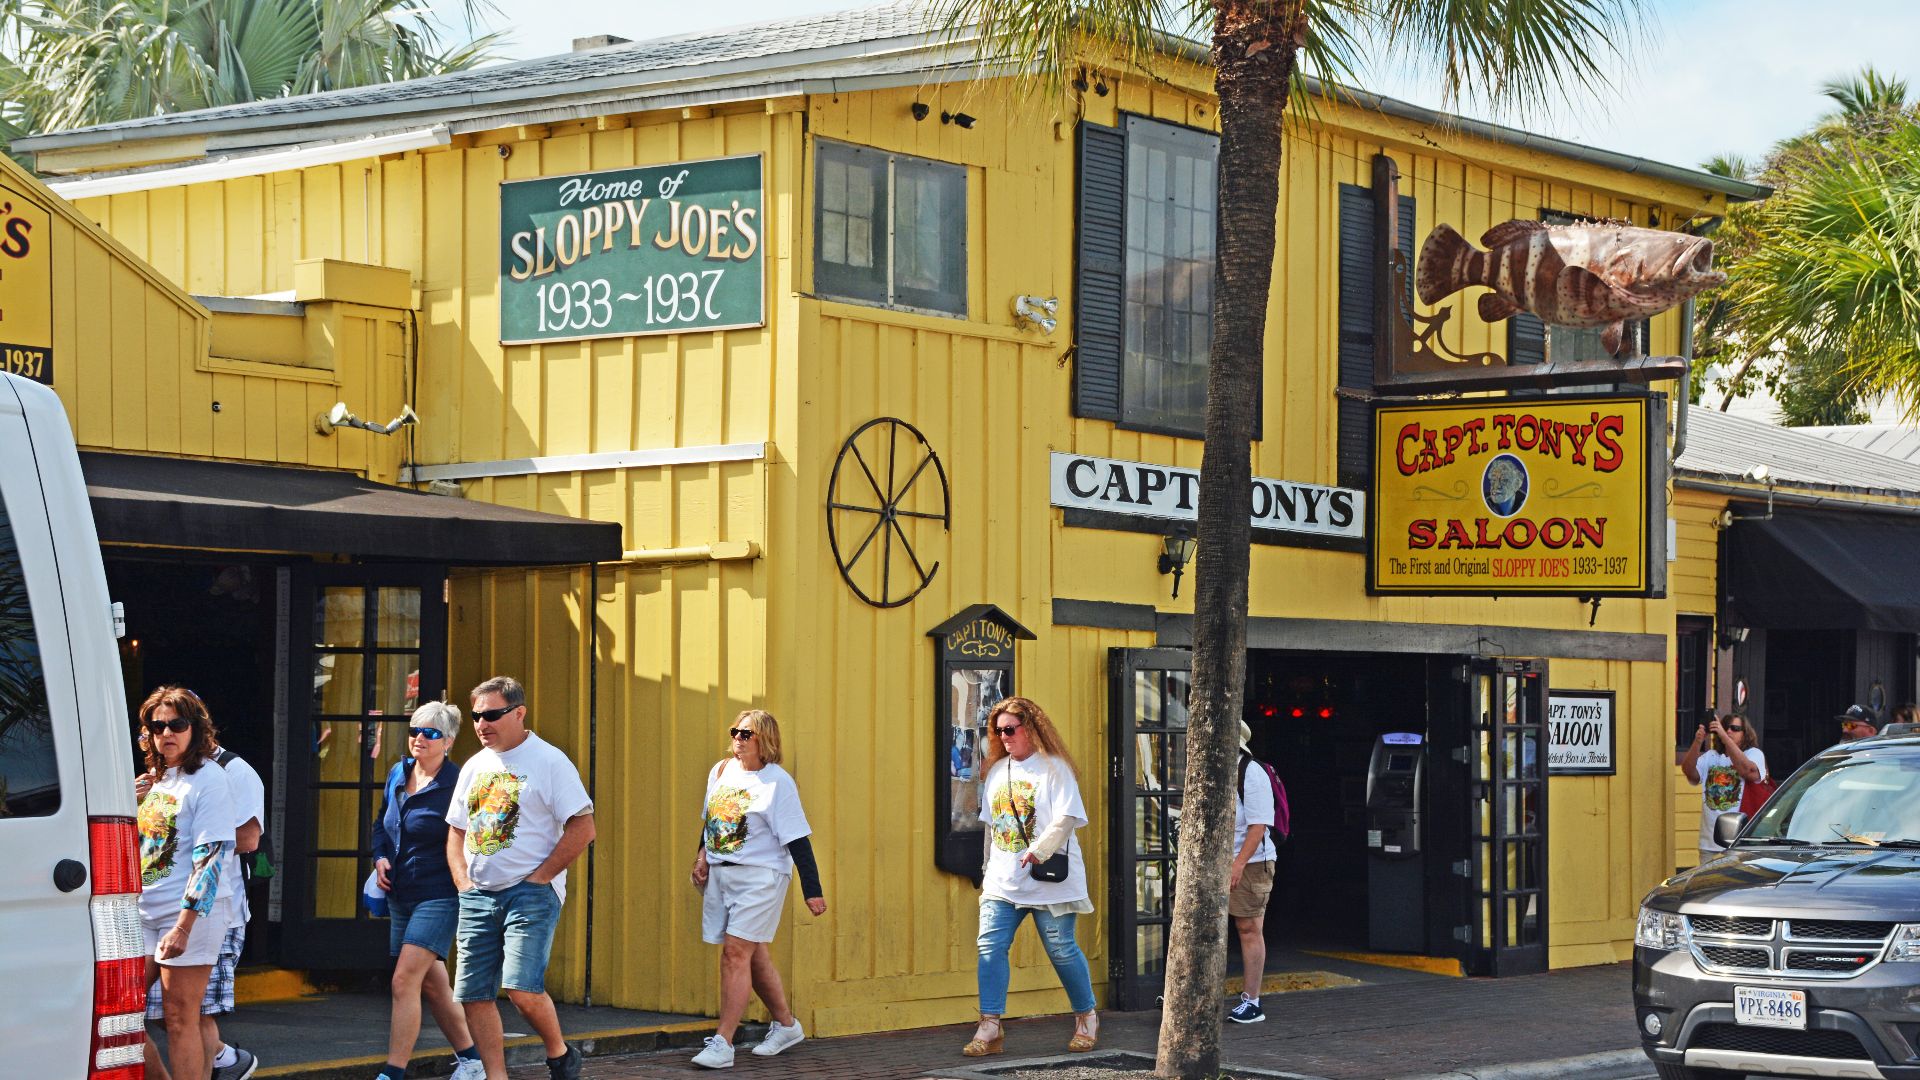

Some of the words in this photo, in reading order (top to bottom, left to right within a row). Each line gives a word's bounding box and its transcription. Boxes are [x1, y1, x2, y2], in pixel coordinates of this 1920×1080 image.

[558, 178, 643, 207] Home
[658, 169, 689, 200] of
[510, 198, 652, 281] SLOPPY
[653, 199, 758, 260] JOE'S
[1396, 417, 1489, 477] CAPT.
[1492, 411, 1625, 473] TONY'S
[1250, 481, 1355, 528] ONY'S
[1408, 517, 1608, 550] SALOON
[1389, 557, 1407, 575] The
[1409, 557, 1432, 575] First
[1434, 557, 1451, 575] and
[1453, 557, 1490, 577] Original
[1492, 557, 1537, 578] SLOPPY
[1539, 557, 1570, 578] JOE'S
[1572, 556, 1628, 575] 1933-1937
[1548, 704, 1567, 719] APT.
[1570, 701, 1602, 720] TONY'S
[1740, 996, 1801, 1018] VPX-8486
[1753, 990, 1786, 999] VIRGINIA
